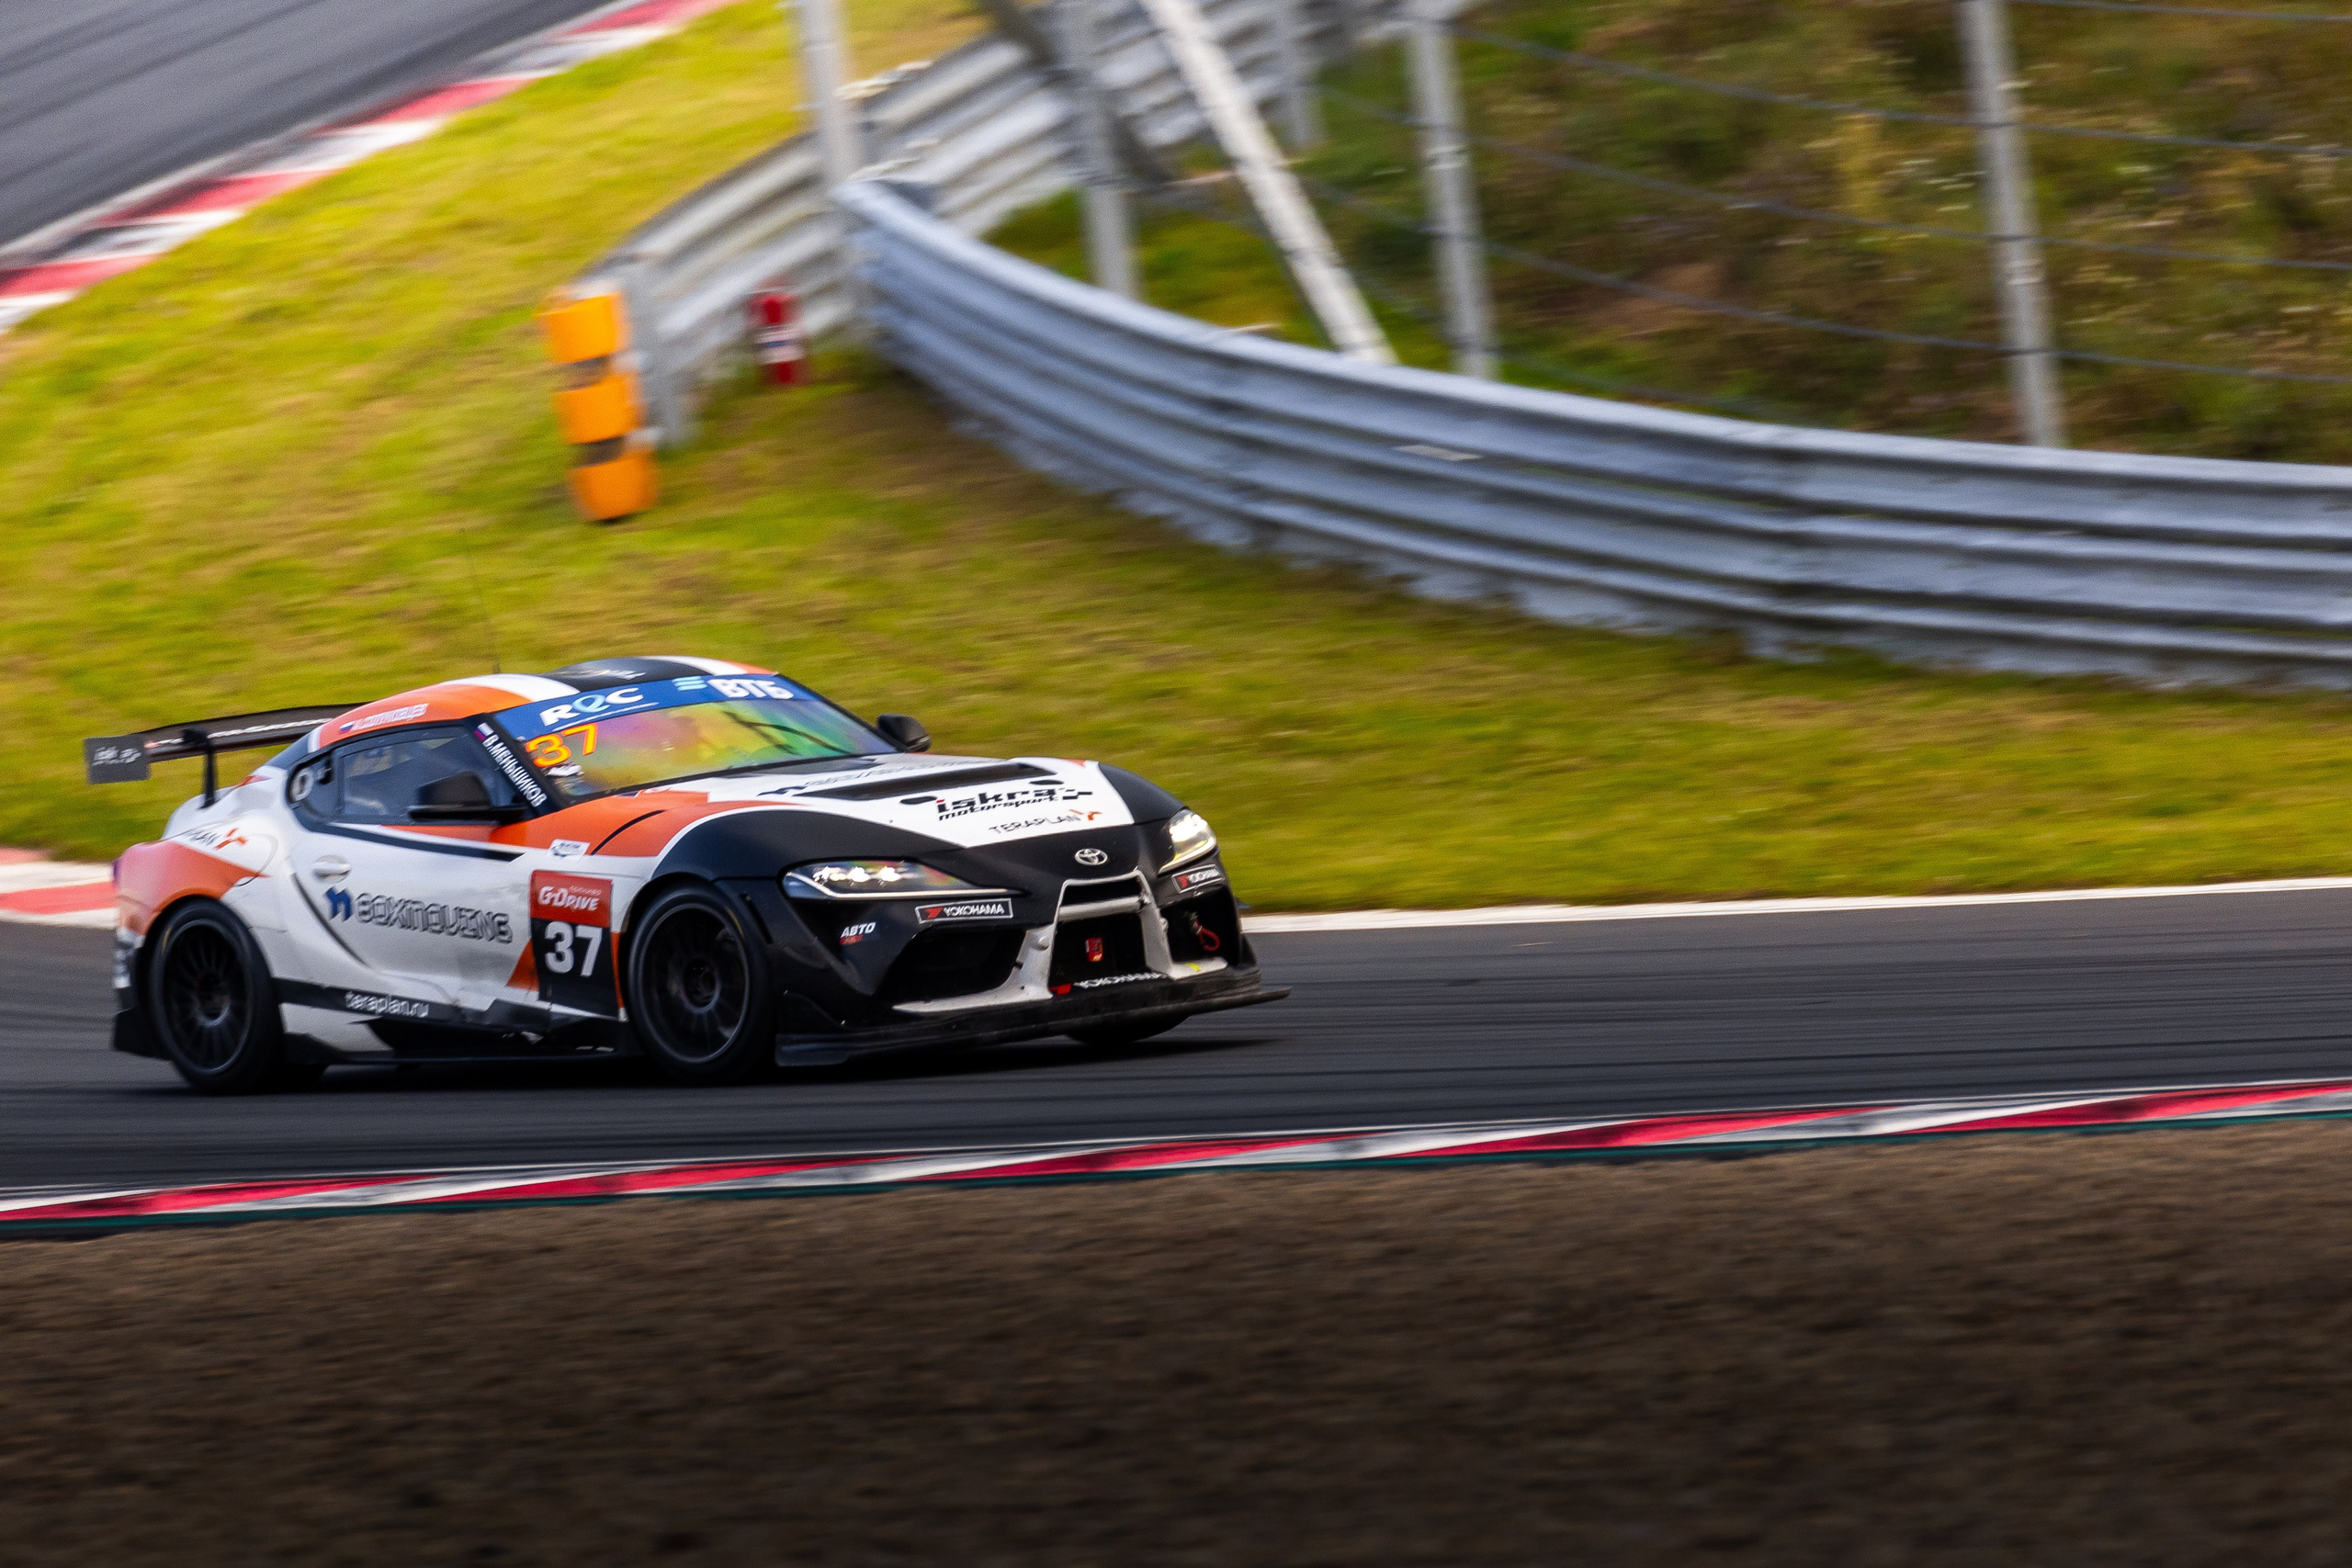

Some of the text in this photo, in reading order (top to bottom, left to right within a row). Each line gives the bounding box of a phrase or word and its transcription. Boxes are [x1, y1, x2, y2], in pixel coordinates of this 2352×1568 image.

[525, 722, 599, 768] 37
[935, 788, 1057, 814] iskra
[938, 795, 1058, 821] motorsport
[989, 814, 1081, 834] TERAPLAN
[944, 904, 1005, 917] YOKOHAMA
[545, 921, 602, 977] 37
